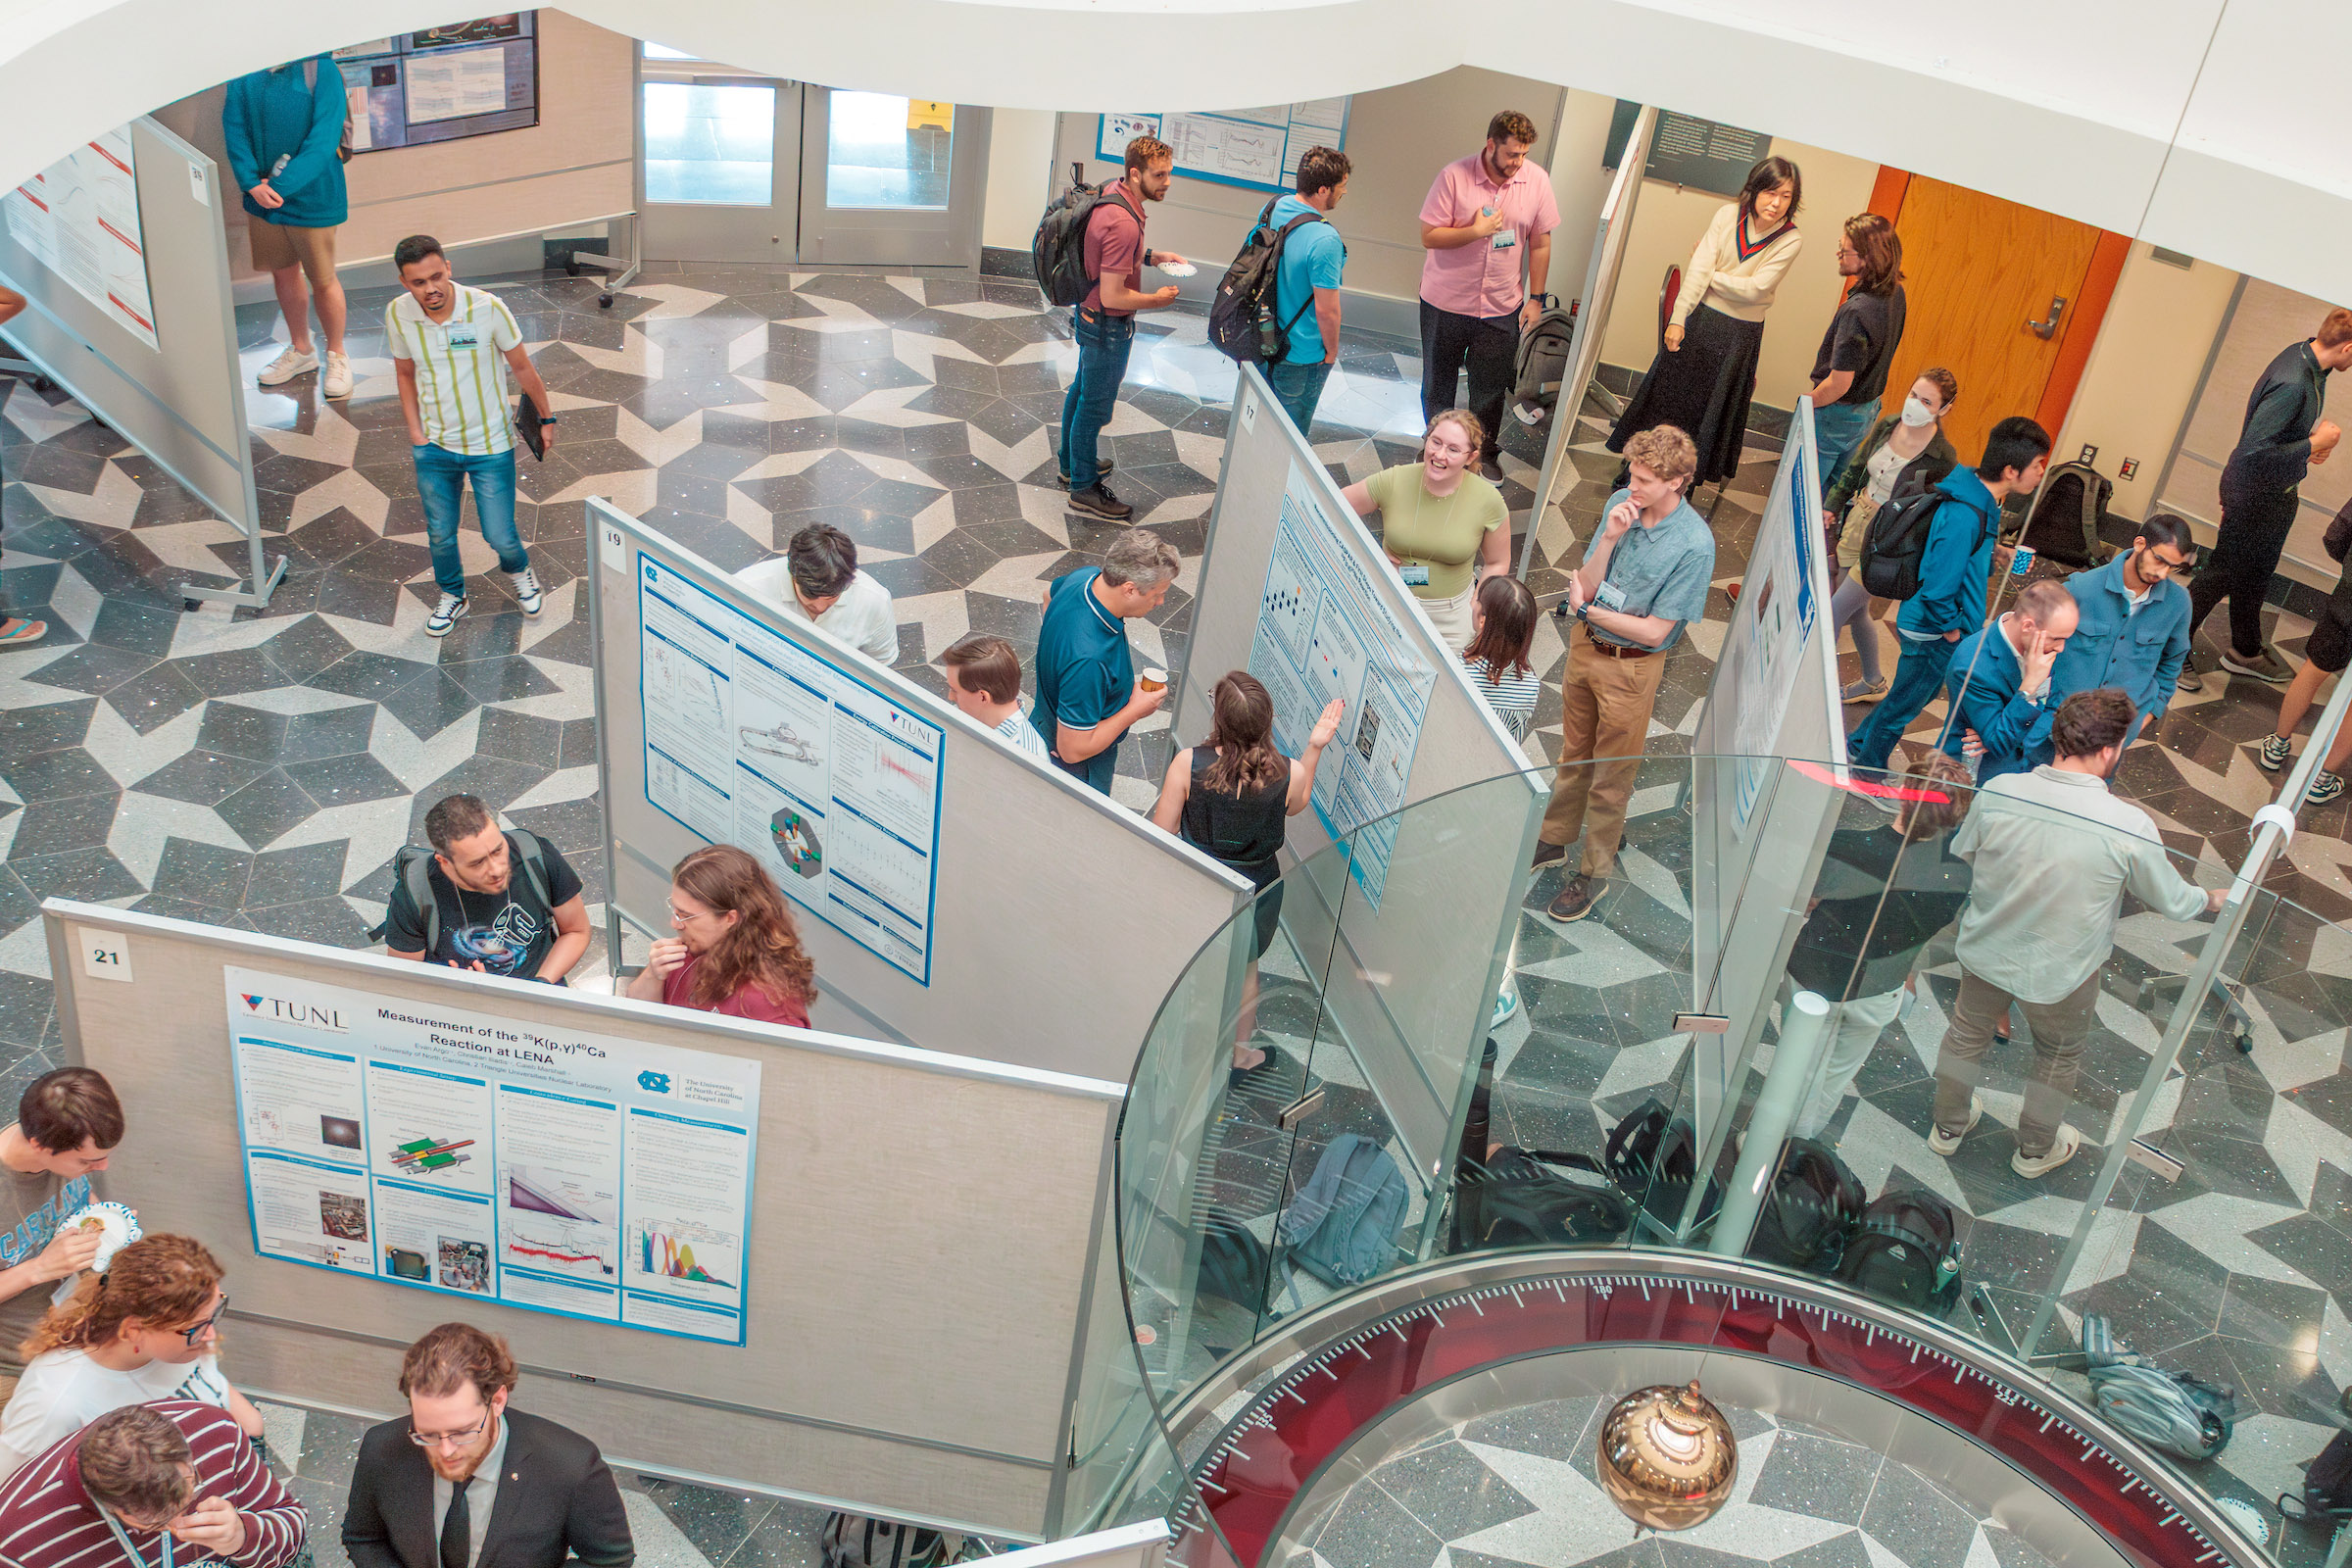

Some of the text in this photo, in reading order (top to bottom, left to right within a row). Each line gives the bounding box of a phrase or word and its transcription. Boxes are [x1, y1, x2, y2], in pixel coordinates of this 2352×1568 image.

[1247, 405, 1254, 419] 17
[607, 530, 620, 546] 19
[901, 716, 933, 746] TUNL
[94, 949, 119, 965] 21
[268, 998, 349, 1029] TUNL
[377, 1007, 474, 1035] Measurement
[477, 1026, 492, 1038] of
[495, 1029, 518, 1043] the
[429, 1033, 554, 1065] Reaction at LENA
[379, 1045, 413, 1056] University
[479, 1062, 507, 1073] Triangle
[508, 1068, 547, 1080] Universities
[548, 1075, 573, 1085] Nuclear
[699, 1080, 734, 1093] University
[692, 1093, 716, 1103] Chapel
[713, 1090, 743, 1101] Carolina
[1592, 1285, 1613, 1295] 180
[1994, 1390, 2016, 1406] 225
[1255, 1412, 1273, 1429] 135
